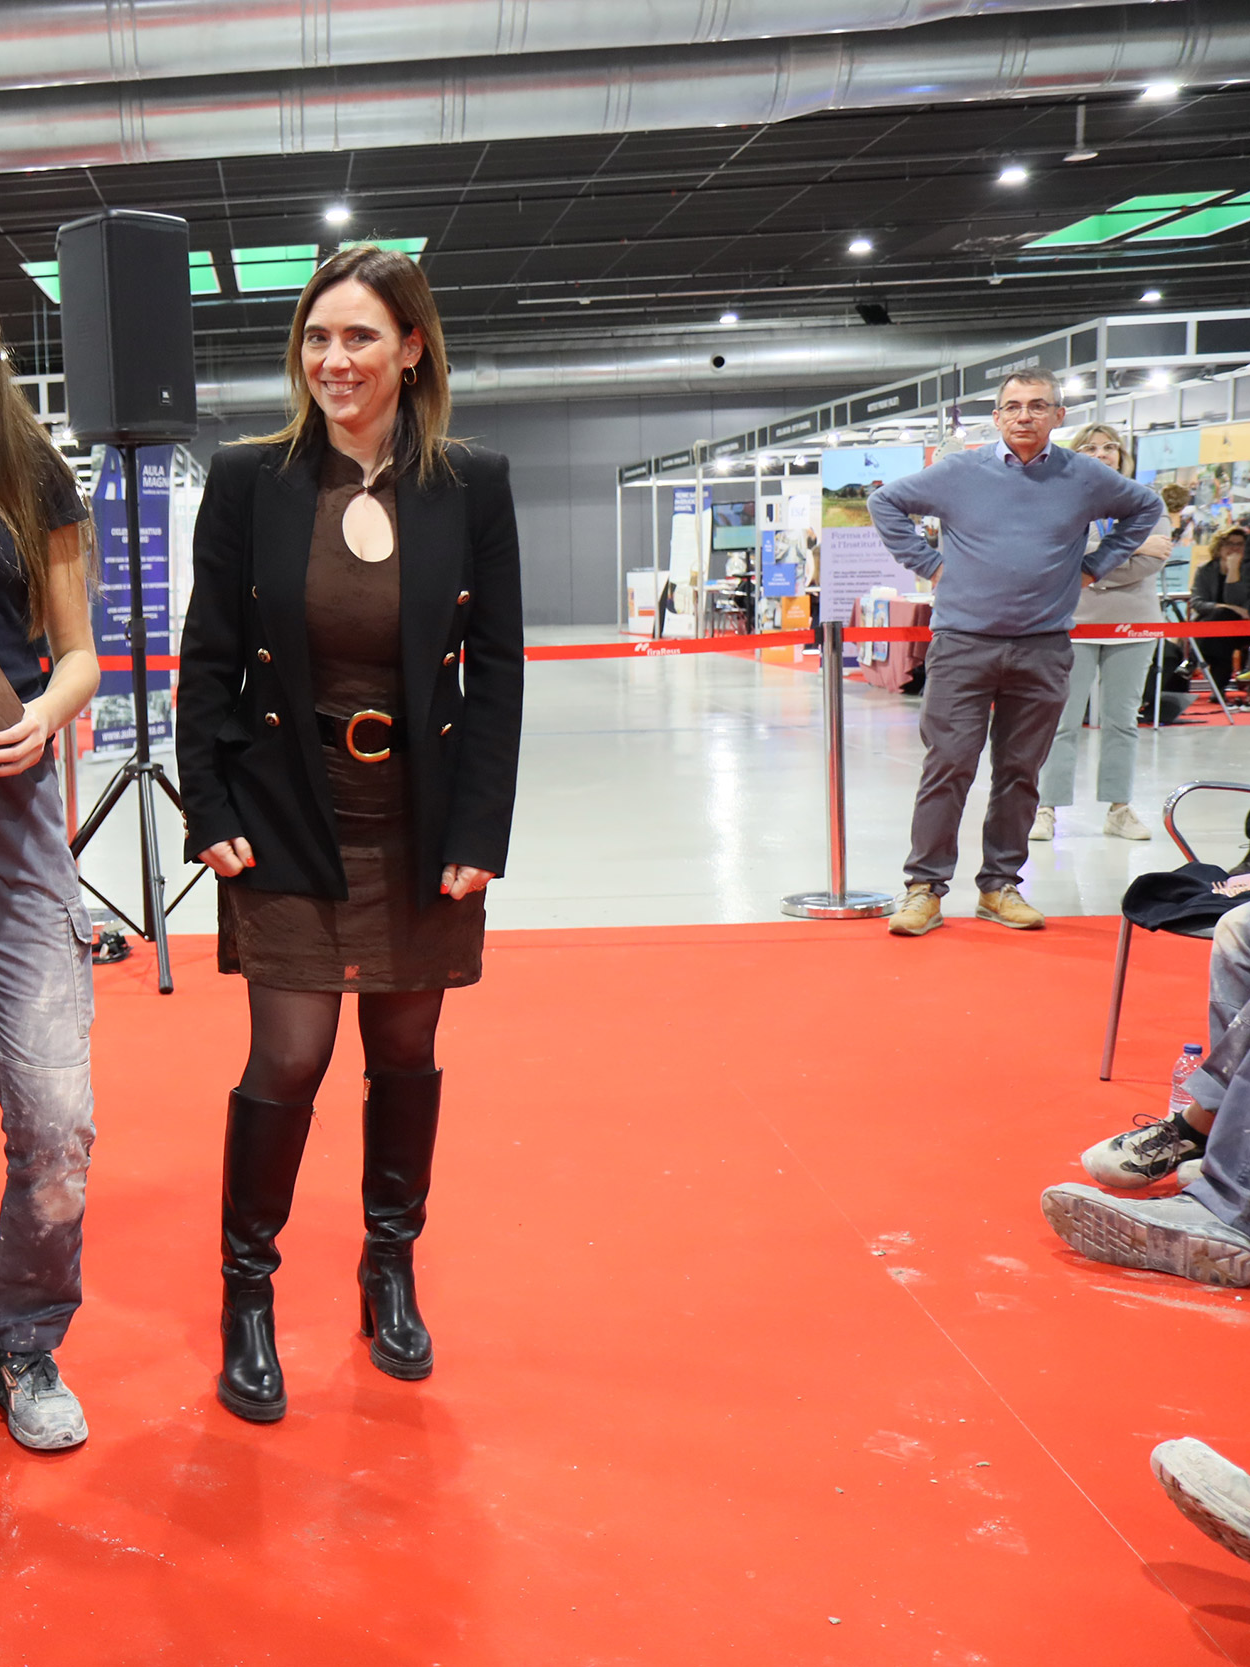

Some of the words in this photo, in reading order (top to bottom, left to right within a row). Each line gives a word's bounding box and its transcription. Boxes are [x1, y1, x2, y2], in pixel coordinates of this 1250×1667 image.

[142, 464, 165, 477] AULA
[142, 476, 170, 488] MAGN
[1127, 630, 1164, 638] firaReus
[647, 648, 681, 656] firaReus
